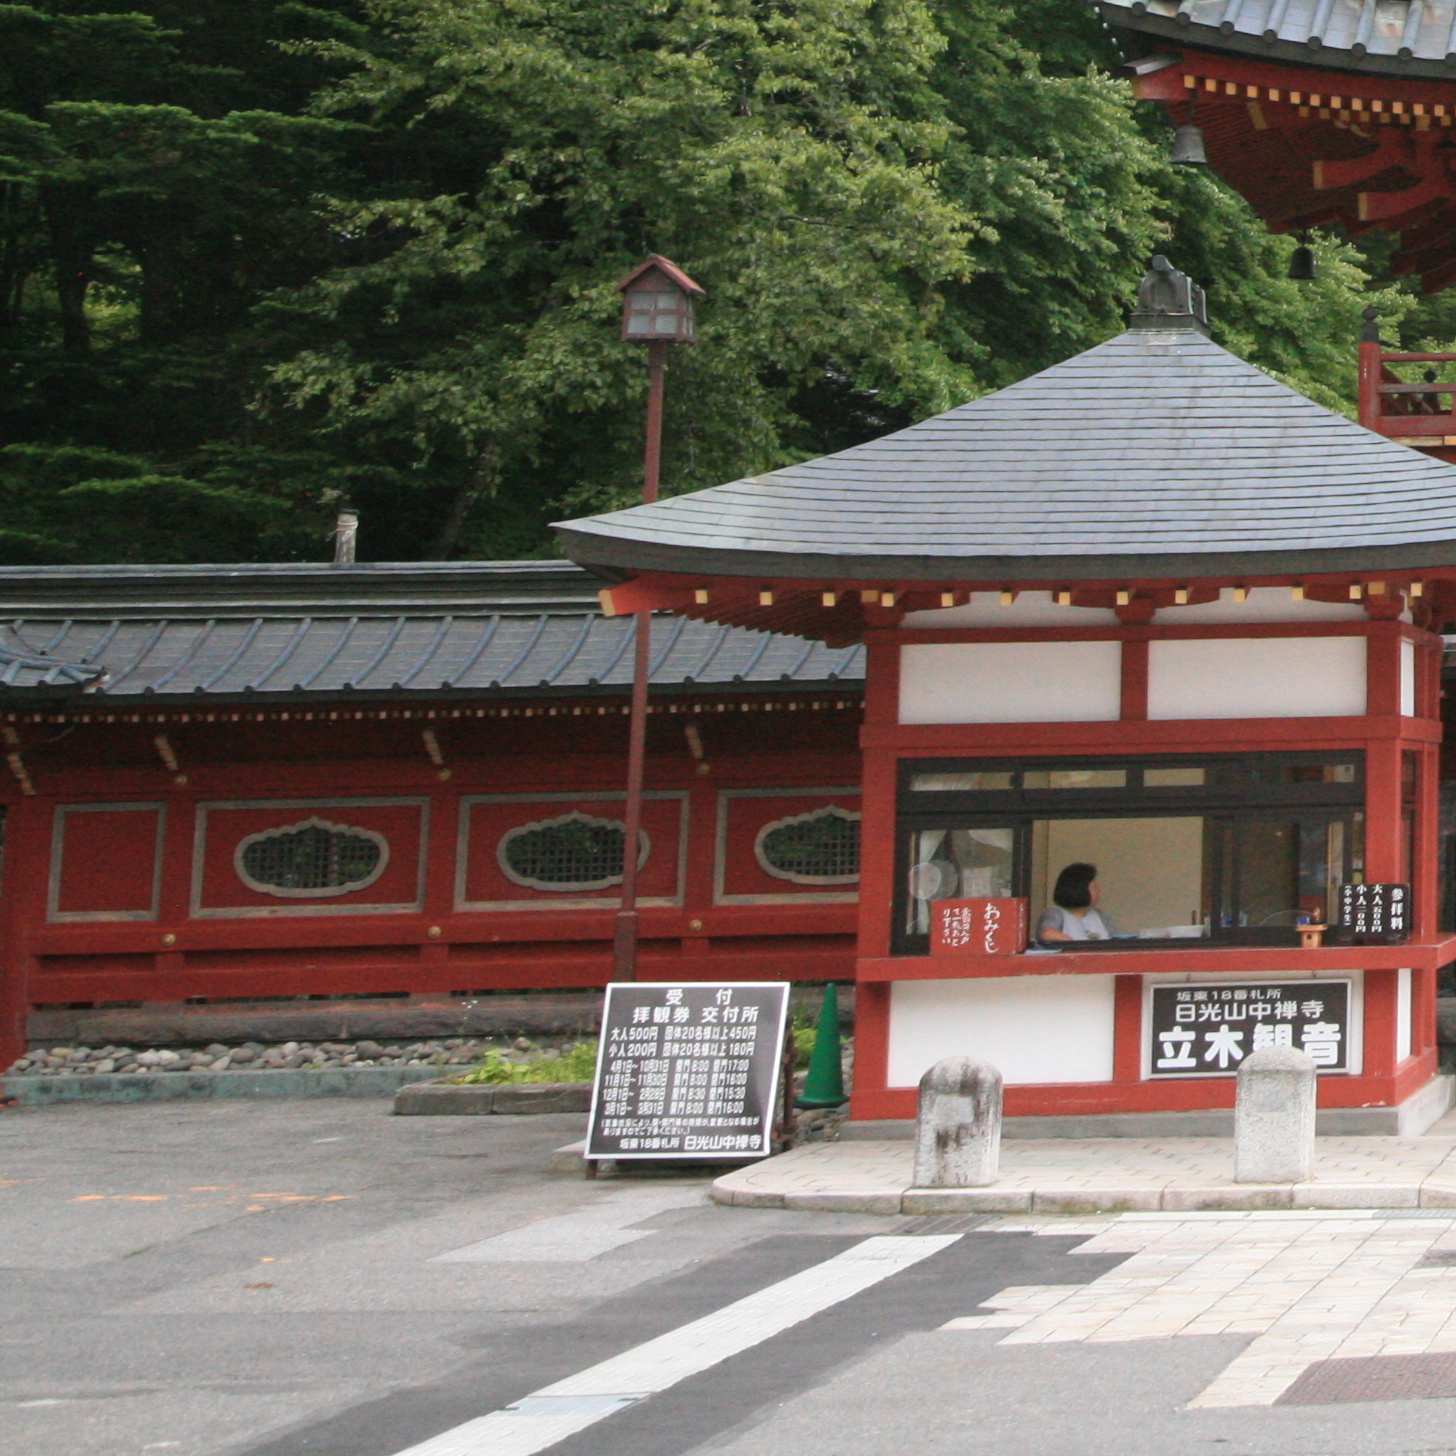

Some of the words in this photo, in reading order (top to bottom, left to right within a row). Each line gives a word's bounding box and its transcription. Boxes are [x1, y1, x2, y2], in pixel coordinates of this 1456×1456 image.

[984, 902, 1000, 954] おみくじ
[1176, 988, 1281, 1001] 坂東18番札所
[633, 1006, 690, 1024] 拝観券
[701, 1006, 759, 1024] 交付所
[1176, 1000, 1325, 1022] 日光山中禅寺
[611, 1026, 658, 1042] 大人500円
[1157, 1022, 1342, 1068] 立木観音
[684, 1135, 762, 1150] 日光山中禅寺
